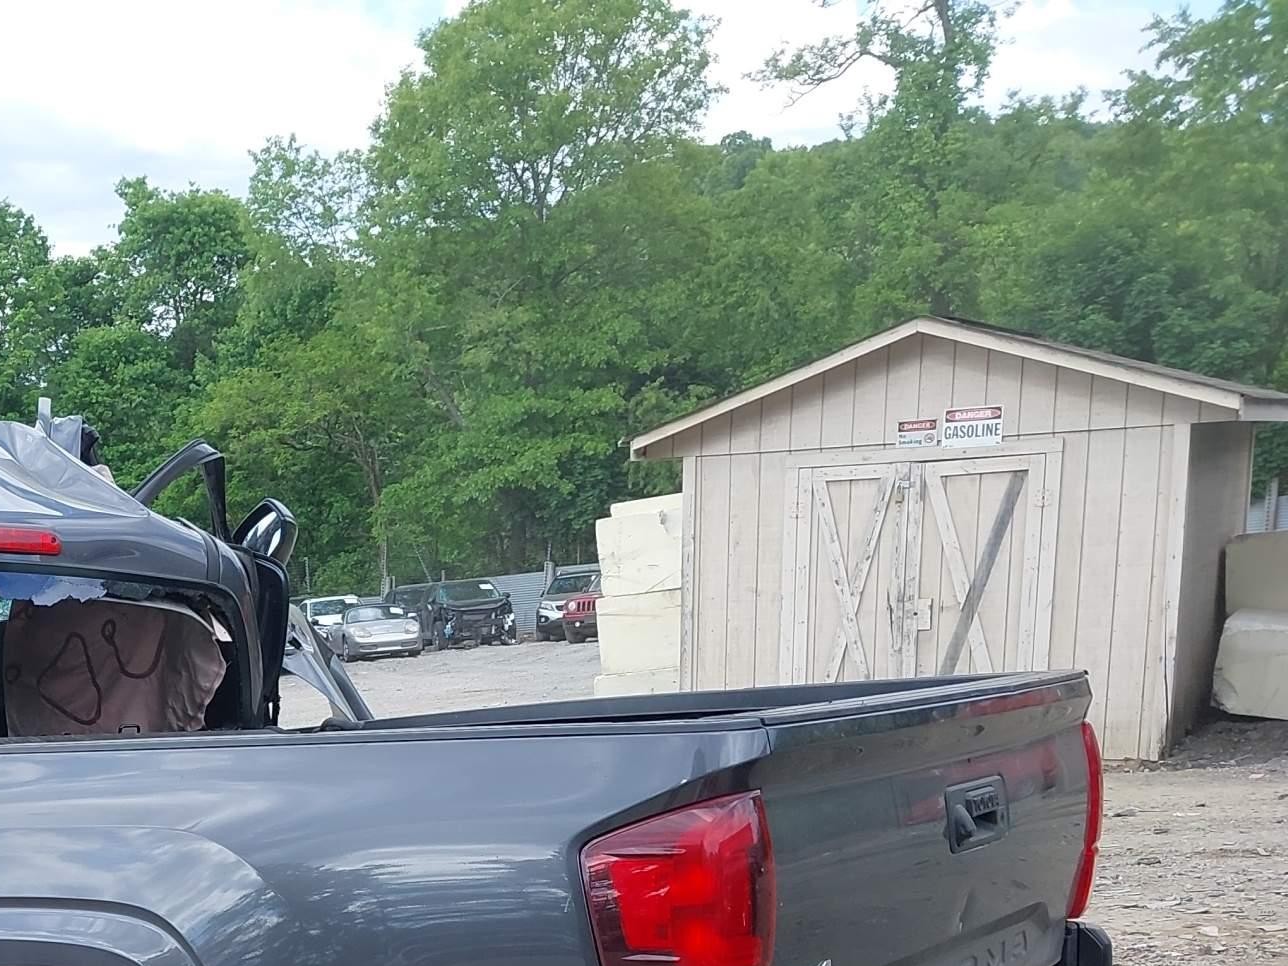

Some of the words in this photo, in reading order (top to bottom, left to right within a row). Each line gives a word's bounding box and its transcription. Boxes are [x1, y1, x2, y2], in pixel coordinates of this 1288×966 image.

[955, 409, 992, 420] DANGER
[903, 422, 931, 431] DANGER
[944, 423, 1001, 440] GASOLINE
